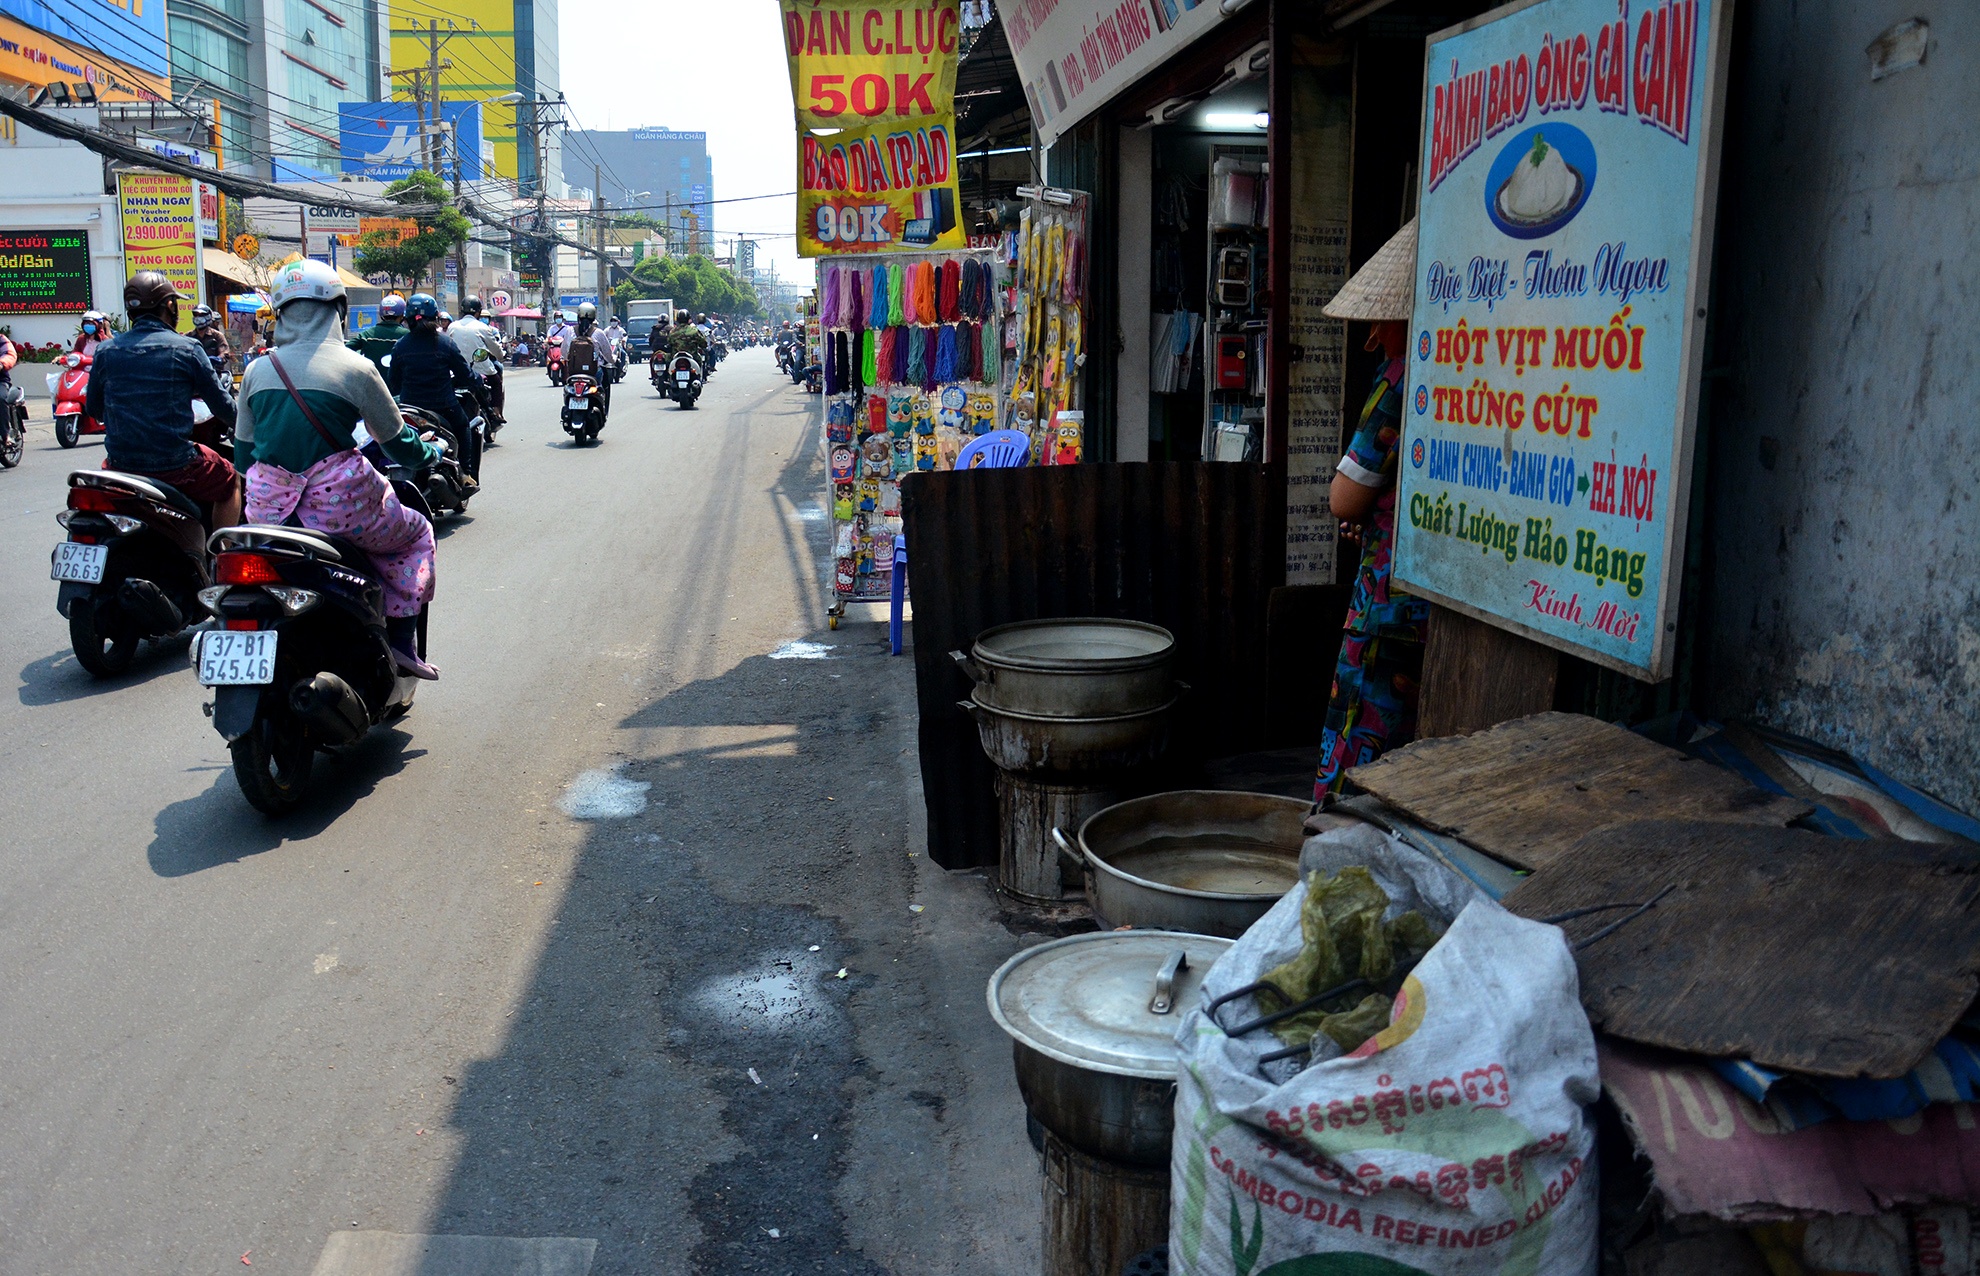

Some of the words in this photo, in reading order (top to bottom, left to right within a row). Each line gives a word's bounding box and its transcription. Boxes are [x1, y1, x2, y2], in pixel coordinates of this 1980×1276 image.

[785, 0, 850, 56] DÁN
[808, 72, 937, 118] 50K
[1429, 57, 1486, 193] BÁNH
[1485, 53, 1531, 139] BAO
[1535, 31, 1591, 115] ÔNG
[634, 131, 656, 140] NGÂN
[656, 131, 677, 140] HÀNG
[684, 131, 704, 140] CHÂU
[802, 131, 849, 191] BAO
[849, 134, 889, 193] DA
[886, 124, 950, 190] IPAD
[127, 196, 158, 208] NHẬN
[162, 197, 191, 206] NGAY
[816, 204, 892, 243] 90K
[166, 255, 195, 265] NGAY
[1427, 260, 1462, 313] Đặc
[1467, 255, 1508, 313] Biệt
[1524, 249, 1588, 298] Thơm
[1593, 241, 1669, 306] Ngon
[1434, 317, 1489, 374] HỘT
[1495, 327, 1547, 377] VỊT
[1552, 306, 1646, 371] MUỐI
[1432, 378, 1525, 431] TRỨNG
[1532, 381, 1599, 438] CÚT
[1429, 429, 1460, 484] BÁNH
[1509, 440, 1547, 501] BÁNH
[1589, 448, 1616, 516] HÀ
[1623, 453, 1657, 533] NỘI
[54, 563, 101, 580] 026.63
[1410, 491, 1453, 535] Chất
[1456, 502, 1520, 563] Lượng
[1524, 516, 1568, 566] Hảo
[1574, 528, 1647, 598] Hạng
[1522, 579, 1583, 625] Kính
[1587, 599, 1641, 643] Mời
[205, 659, 268, 681] 545.46
[214, 635, 265, 657] 37-B1
[1209, 1145, 1363, 1234] CAMBODIA
[1372, 1214, 1518, 1249] REFINED
[1522, 1156, 1584, 1231] SUGAR
